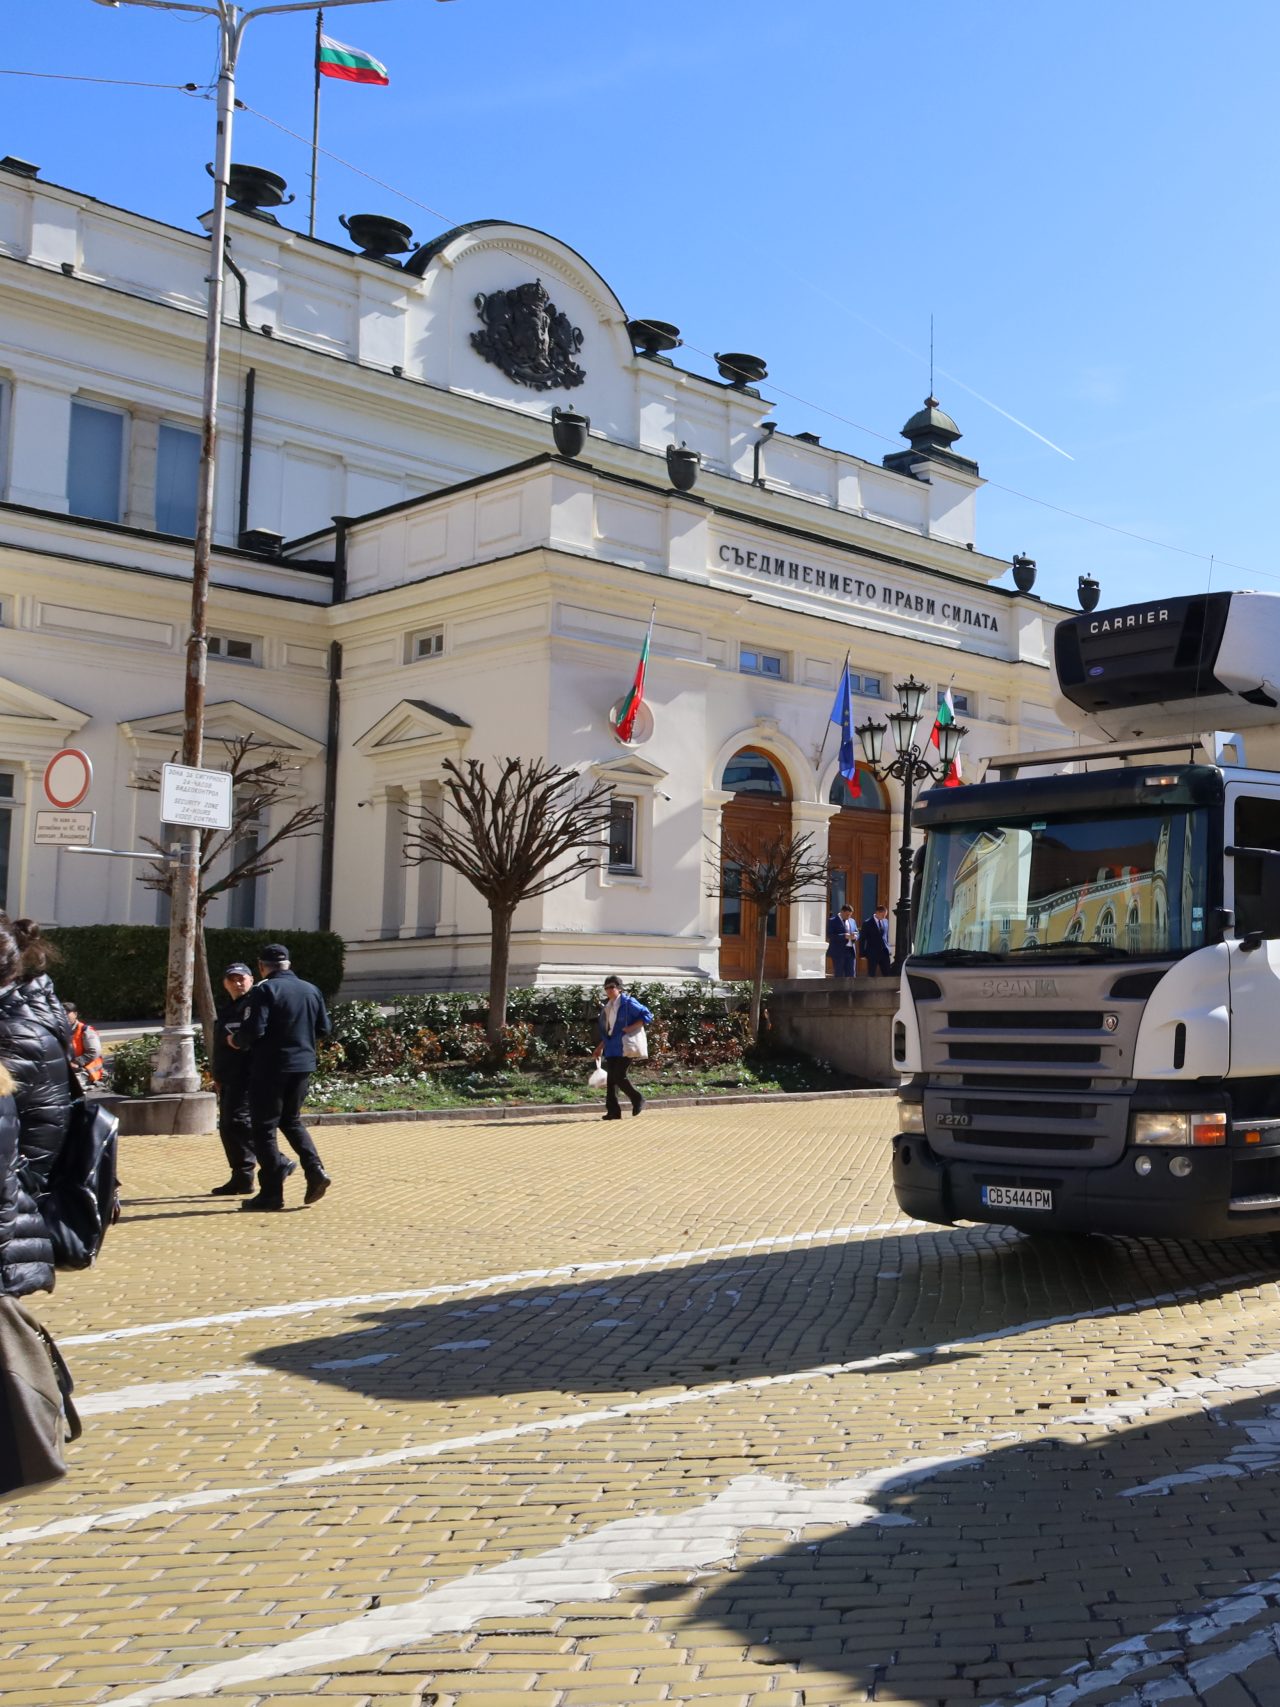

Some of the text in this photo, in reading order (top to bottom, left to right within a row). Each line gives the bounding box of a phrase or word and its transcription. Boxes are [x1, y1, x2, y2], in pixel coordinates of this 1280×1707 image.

[719, 544, 998, 632] СЪЕДИНЕНИЕТО ПРАВИ СИЛАТА
[1090, 609, 1168, 634] CARRIER
[173, 797, 201, 806] SECURITY
[981, 979, 1059, 999] SCANIA
[1005, 1189, 1033, 1207] 5444
